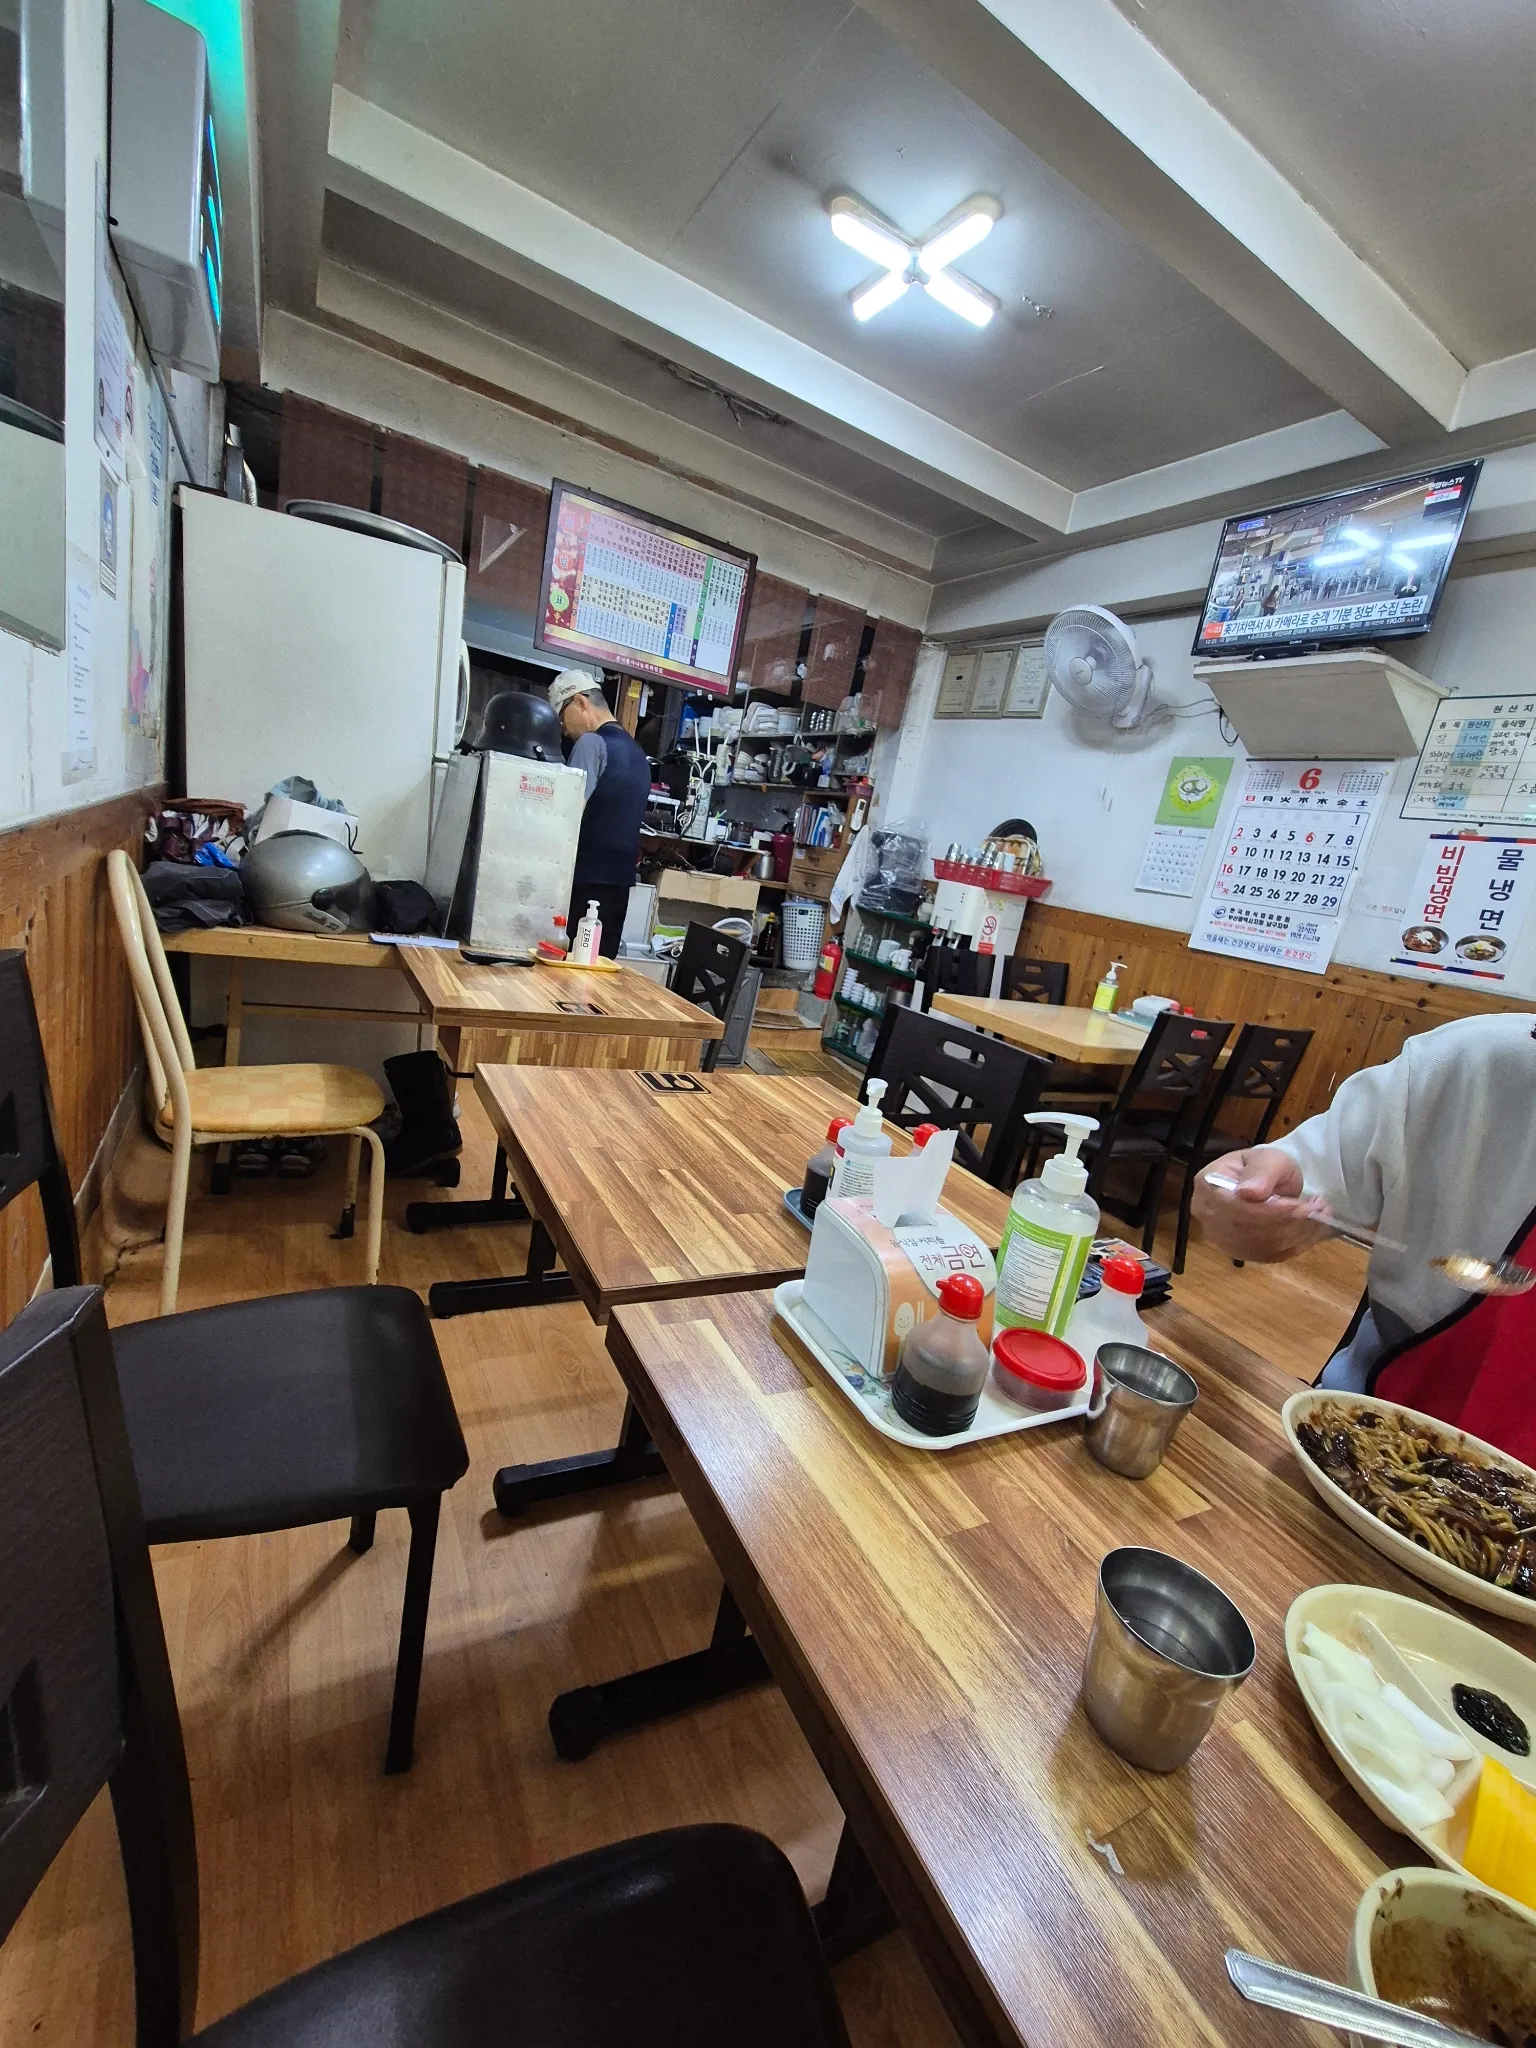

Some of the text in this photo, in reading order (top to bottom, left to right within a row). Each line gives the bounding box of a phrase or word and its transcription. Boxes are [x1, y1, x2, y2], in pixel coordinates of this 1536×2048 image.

[1274, 613, 1309, 629] 카메라로
[1311, 610, 1330, 626] 승객
[1377, 601, 1399, 616] 수집
[1400, 598, 1423, 614] 논란
[1467, 720, 1491, 729] 원산지
[1501, 719, 1527, 728] 음식명
[1299, 768, 1323, 791] 6
[1356, 799, 1368, 807] 土
[1354, 815, 1360, 824] 1
[1236, 828, 1354, 845] 2 3 4 5 6 7 8
[1231, 846, 1350, 867] 9 10 11 12 13 14 15
[1222, 864, 1344, 887] 16 17 18 19 20 21 22
[1423, 846, 1466, 924] 비빔냉면
[1232, 885, 1245, 895] 24
[1249, 887, 1263, 897] 25
[1267, 888, 1280, 899] 26
[1284, 891, 1299, 901] 27
[1303, 894, 1318, 905] 28
[1322, 896, 1338, 907] 29
[1479, 848, 1525, 931] 물냉면
[582, 928, 591, 948] ZERO
[1231, 938, 1256, 949] 건강생각
[919, 1243, 986, 1271] 전체 금연
